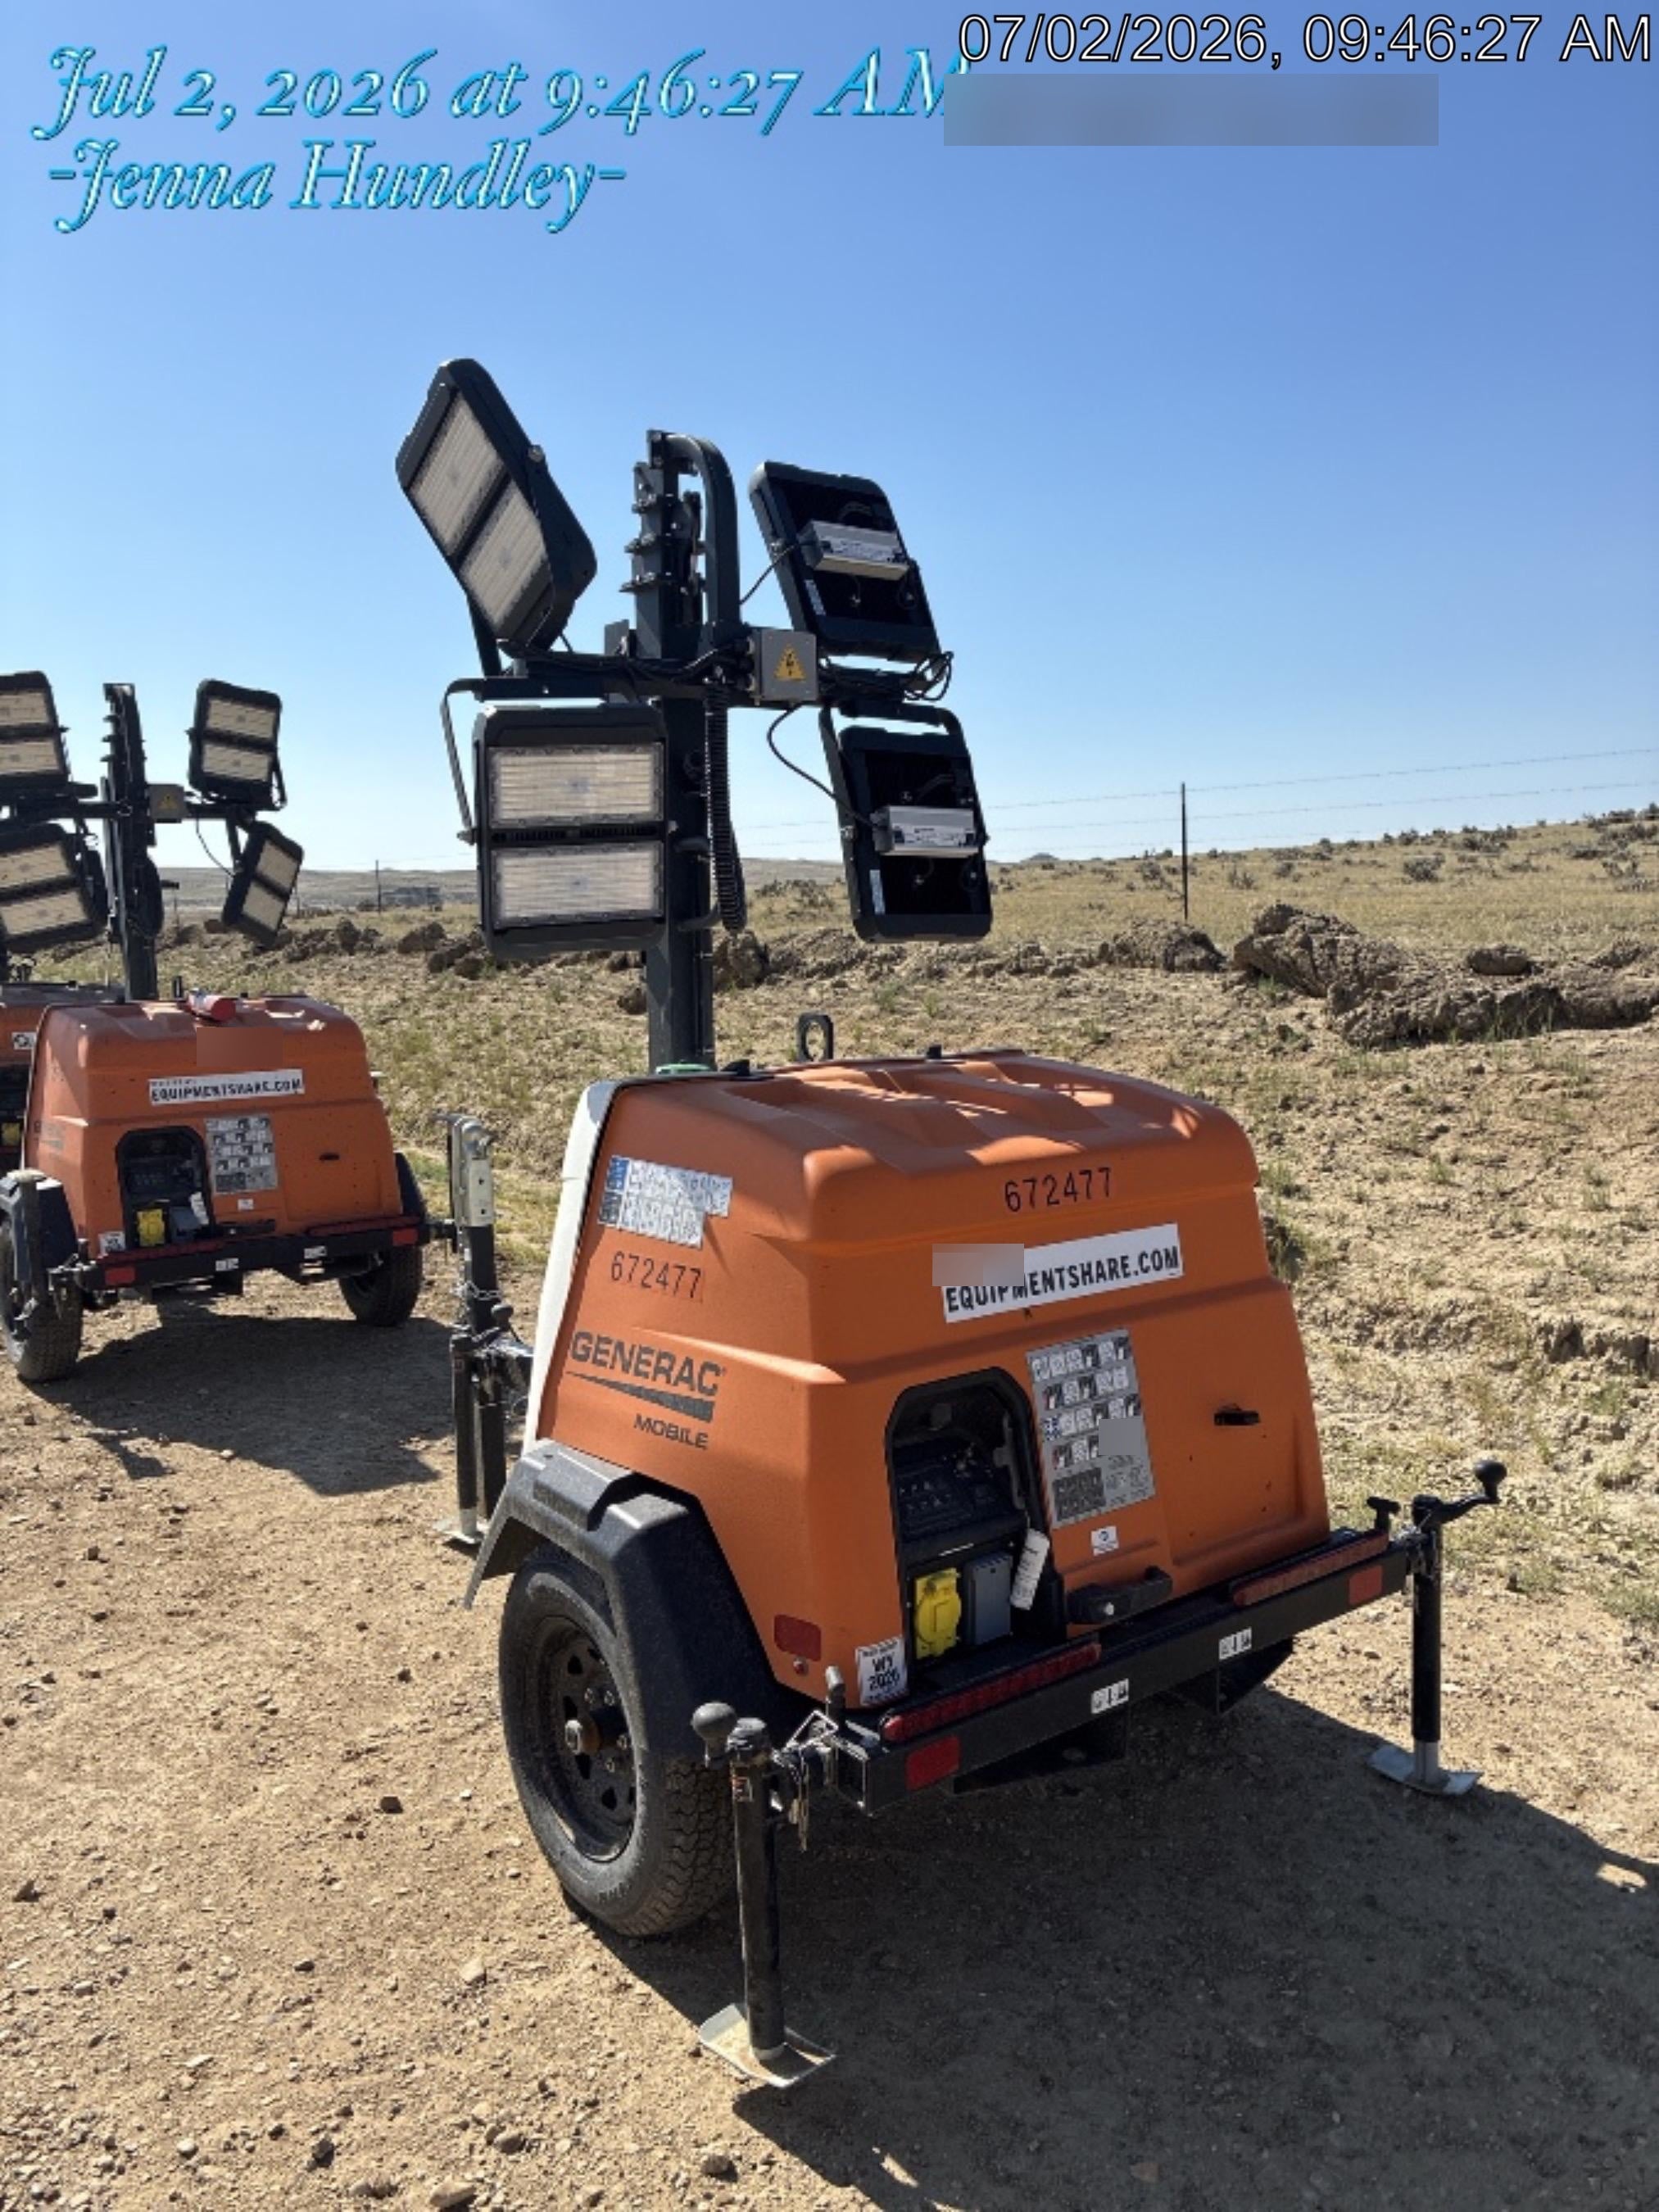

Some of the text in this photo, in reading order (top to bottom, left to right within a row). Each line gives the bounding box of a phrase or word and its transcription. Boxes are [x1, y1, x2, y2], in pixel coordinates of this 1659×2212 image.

[1004, 1167, 1112, 1213] 672477
[610, 1250, 702, 1299] 672477
[570, 1331, 722, 1397] GENERAC
[633, 1412, 709, 1450] MOBILE
